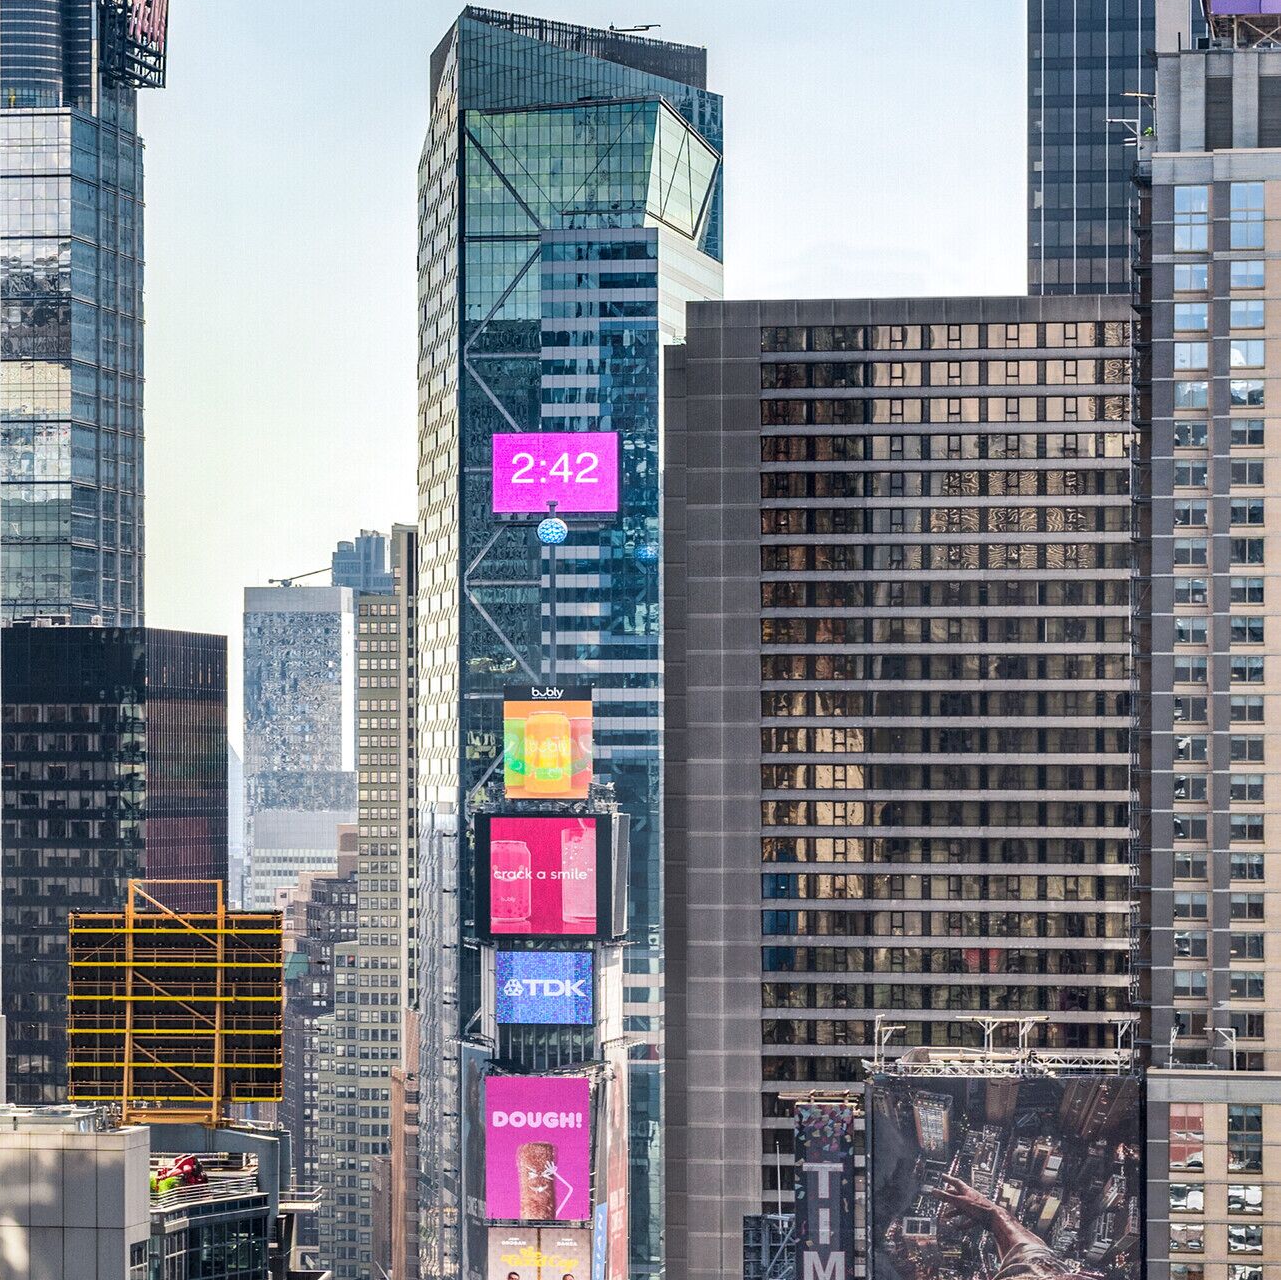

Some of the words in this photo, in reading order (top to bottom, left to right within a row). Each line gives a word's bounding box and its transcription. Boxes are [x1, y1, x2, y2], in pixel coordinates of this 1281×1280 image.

[510, 451, 600, 484] 2:42
[531, 686, 564, 699] bubly
[493, 867, 532, 880] crack
[536, 870, 546, 880] a
[522, 979, 587, 997] TDK
[492, 1110, 583, 1129] DOUGH!
